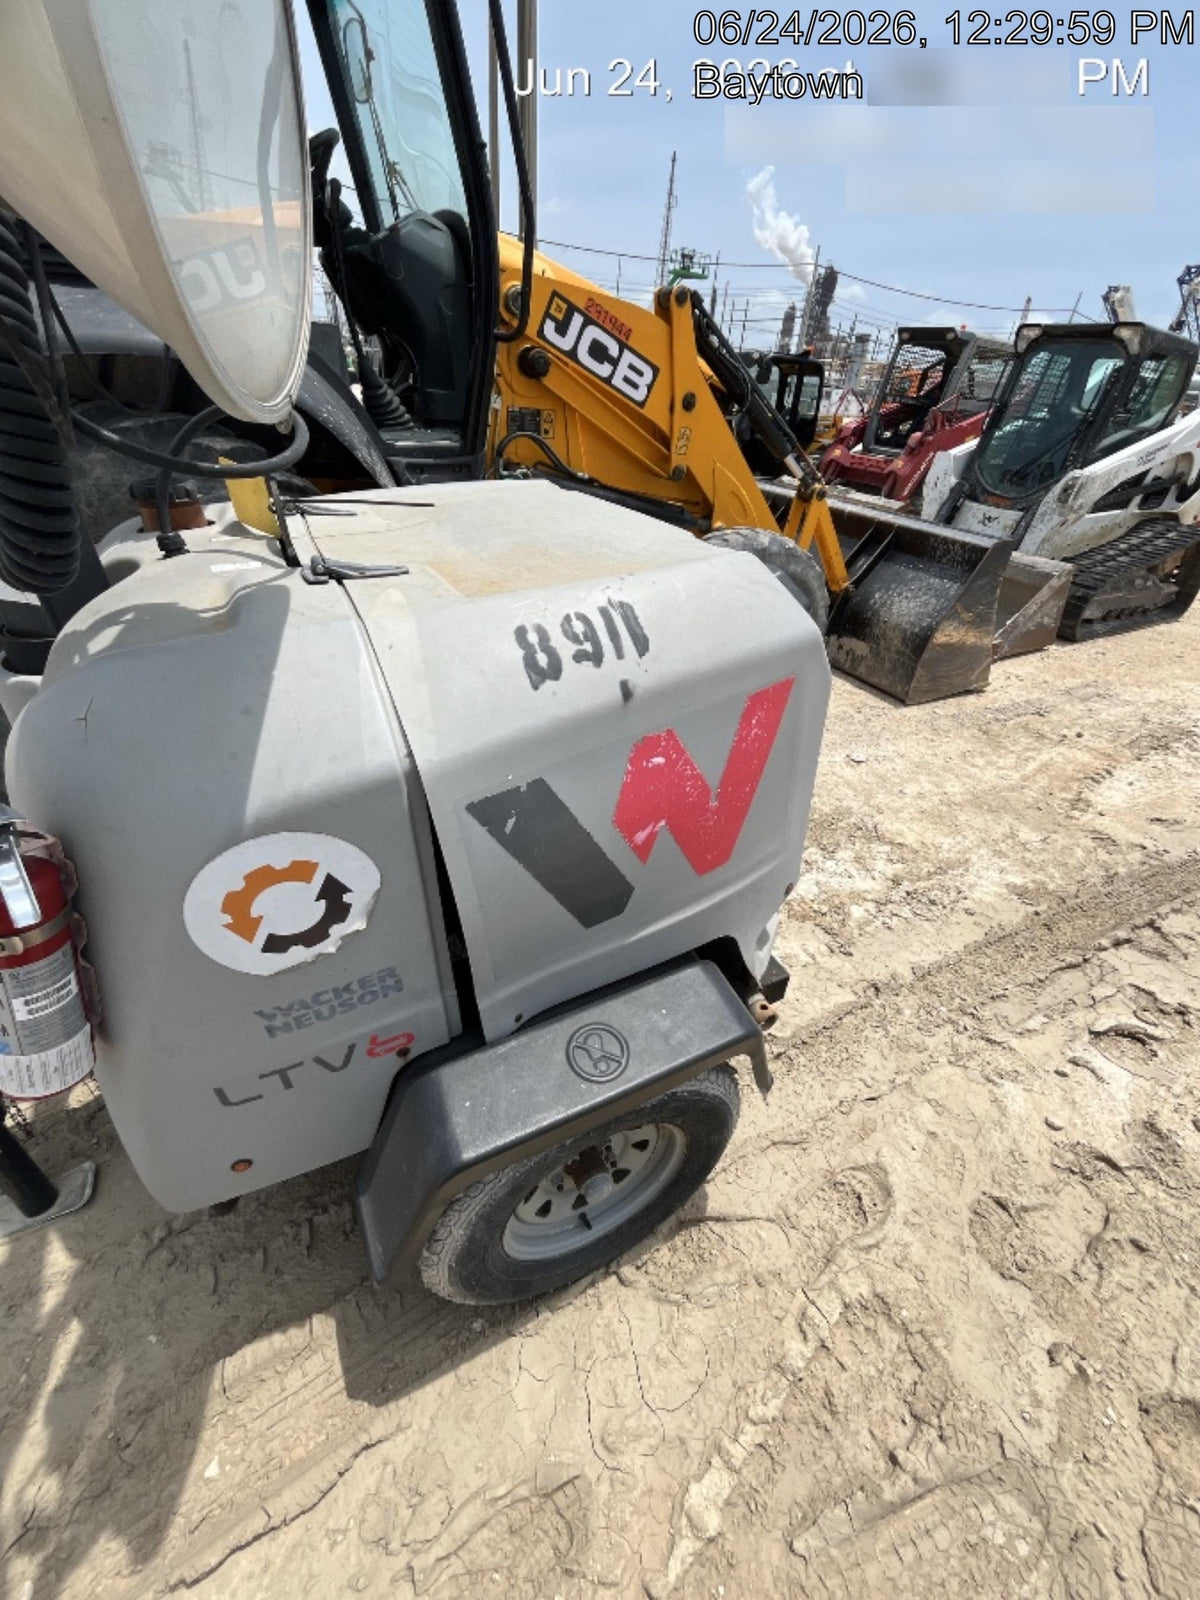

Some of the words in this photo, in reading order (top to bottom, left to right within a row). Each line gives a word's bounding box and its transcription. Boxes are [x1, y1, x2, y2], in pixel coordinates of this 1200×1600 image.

[542, 311, 654, 404] JCB
[253, 966, 400, 1022] WACKER
[264, 975, 404, 1039] NEUSON
